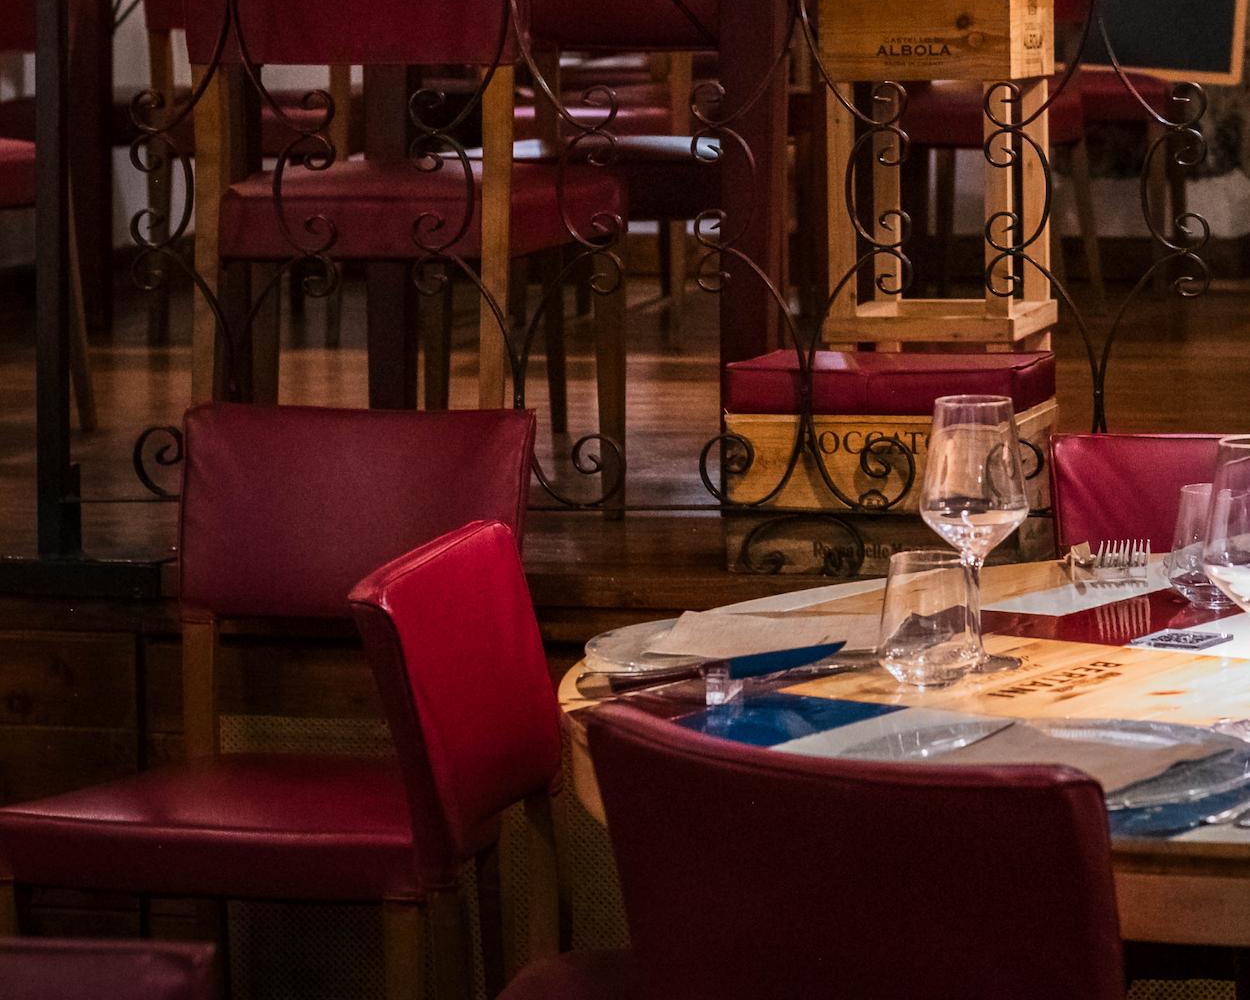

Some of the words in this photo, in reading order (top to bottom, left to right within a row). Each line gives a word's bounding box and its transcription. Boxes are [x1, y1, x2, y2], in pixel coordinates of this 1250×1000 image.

[876, 44, 951, 56] ALBOLA
[803, 430, 929, 455] OCCAT
[857, 543, 890, 559] elle
[987, 661, 1124, 698] BERTANI
